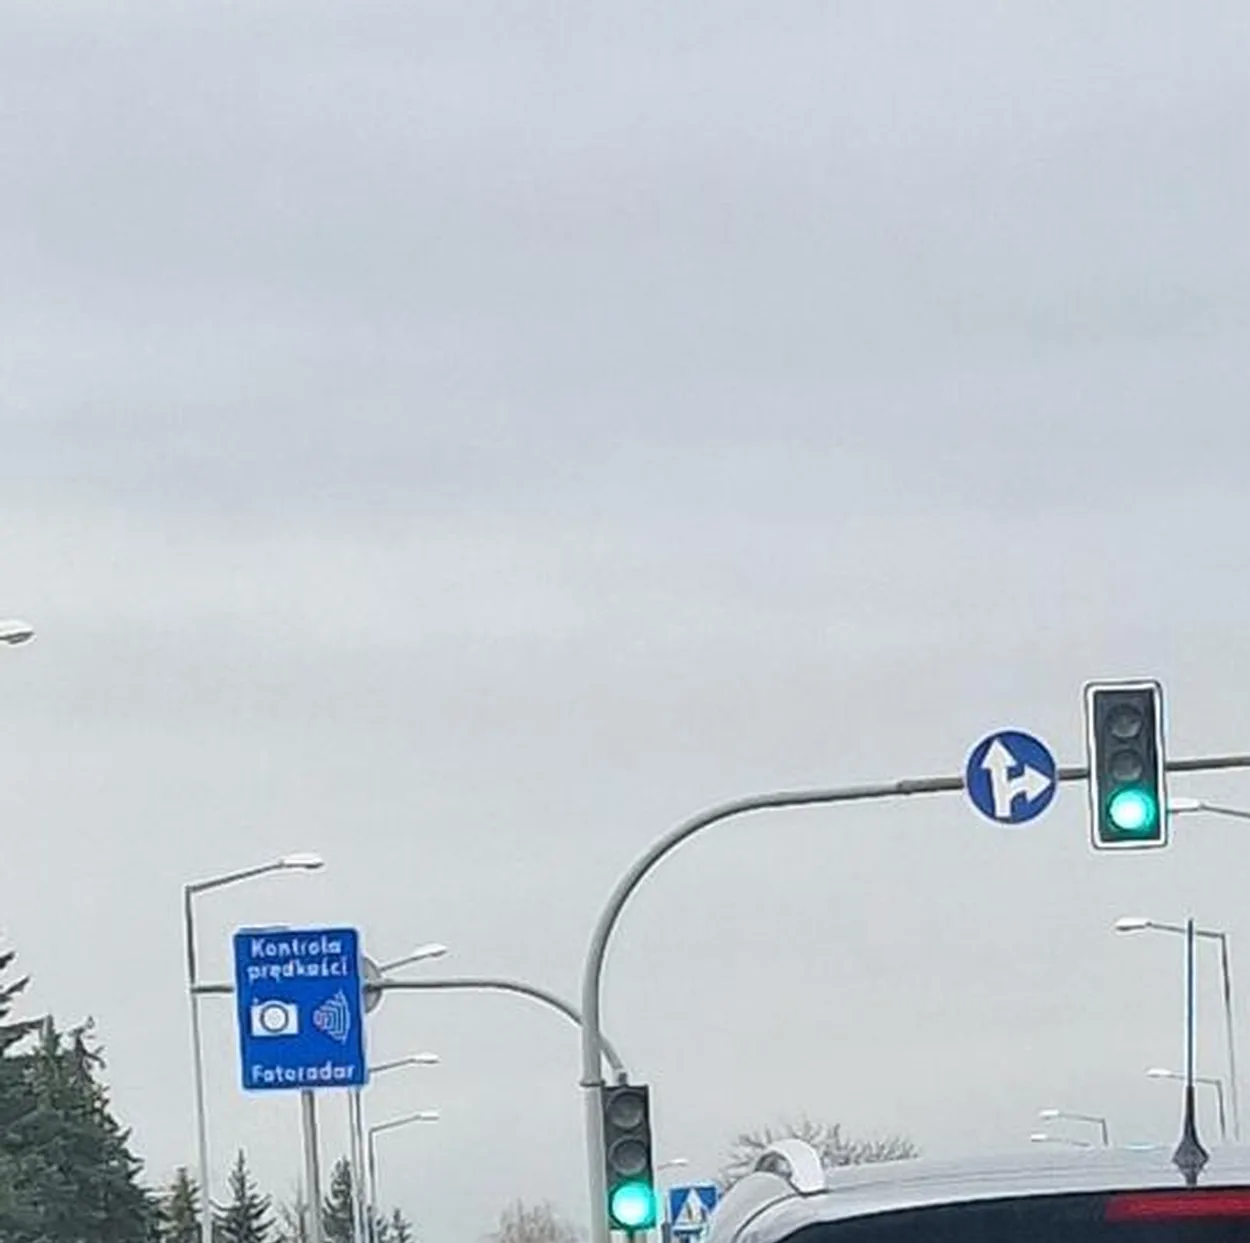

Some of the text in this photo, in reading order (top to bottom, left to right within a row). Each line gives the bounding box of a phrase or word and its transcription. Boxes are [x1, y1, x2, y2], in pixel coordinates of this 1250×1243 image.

[251, 937, 343, 958] Kontrola
[247, 956, 349, 983] prędkości
[251, 1061, 356, 1084] Fotoradar
